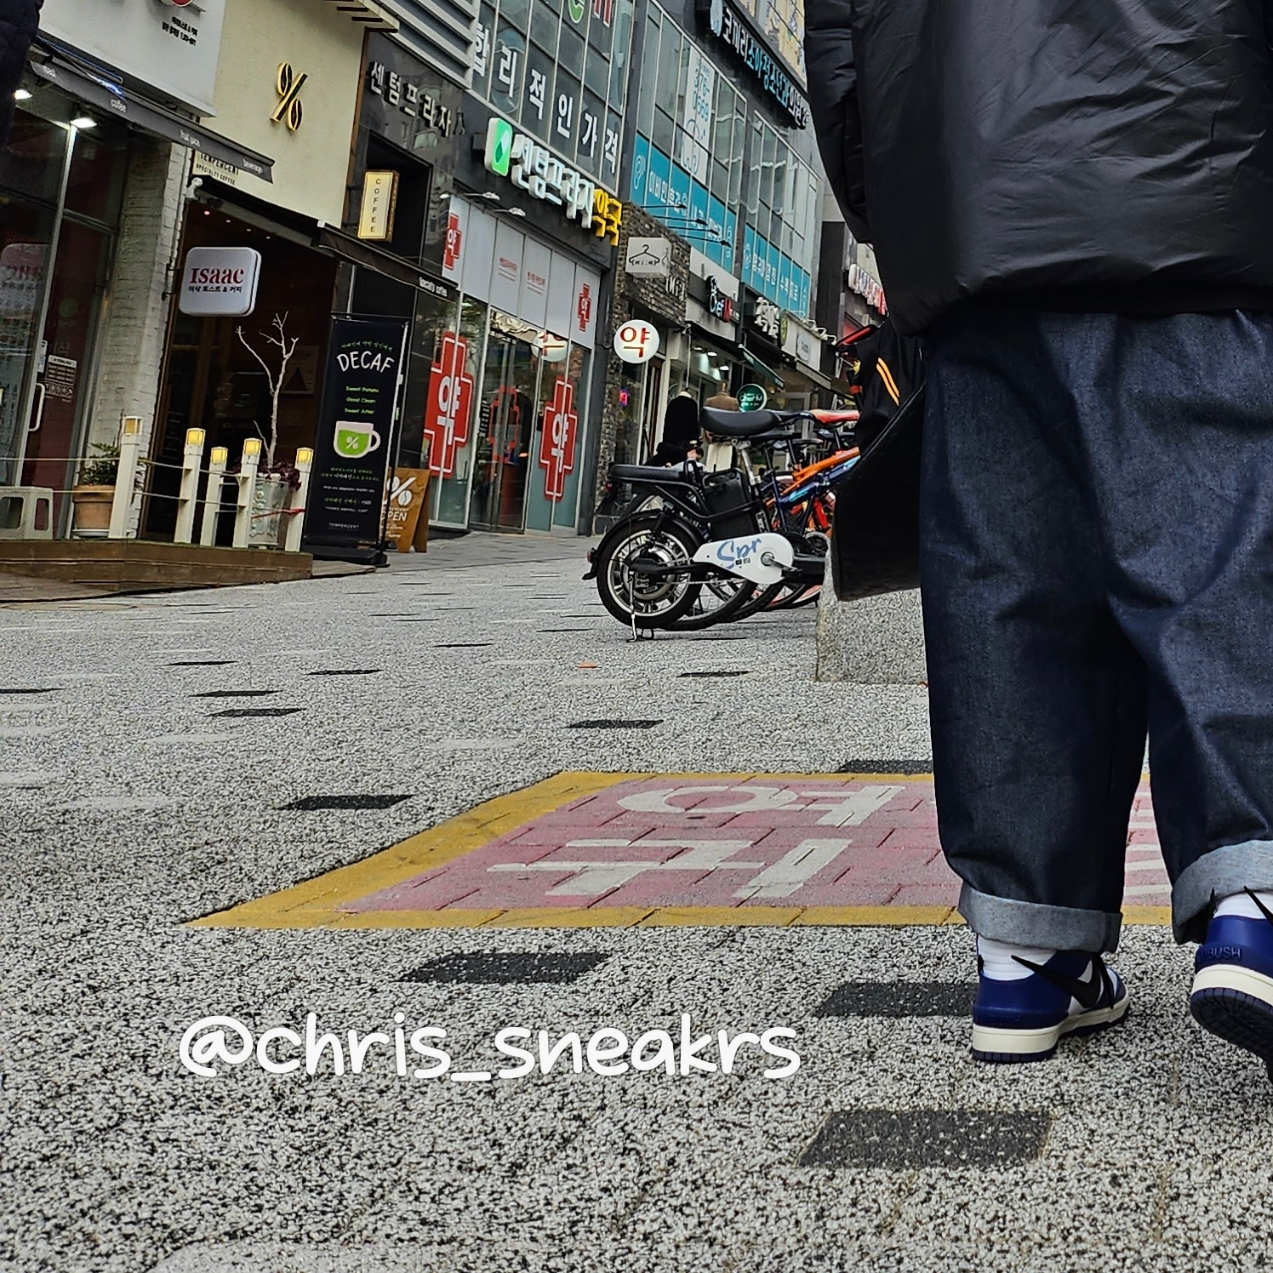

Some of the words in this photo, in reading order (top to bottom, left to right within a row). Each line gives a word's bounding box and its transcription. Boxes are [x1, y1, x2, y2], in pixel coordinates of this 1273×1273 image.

[369, 60, 453, 139] 센텀프라자
[371, 177, 383, 235] COFFEE
[447, 228, 458, 258] 약
[190, 267, 244, 284] Isaac
[336, 350, 395, 374] DECAF
[620, 326, 651, 358] 약
[438, 373, 462, 448] 약
[551, 411, 570, 471] 약
